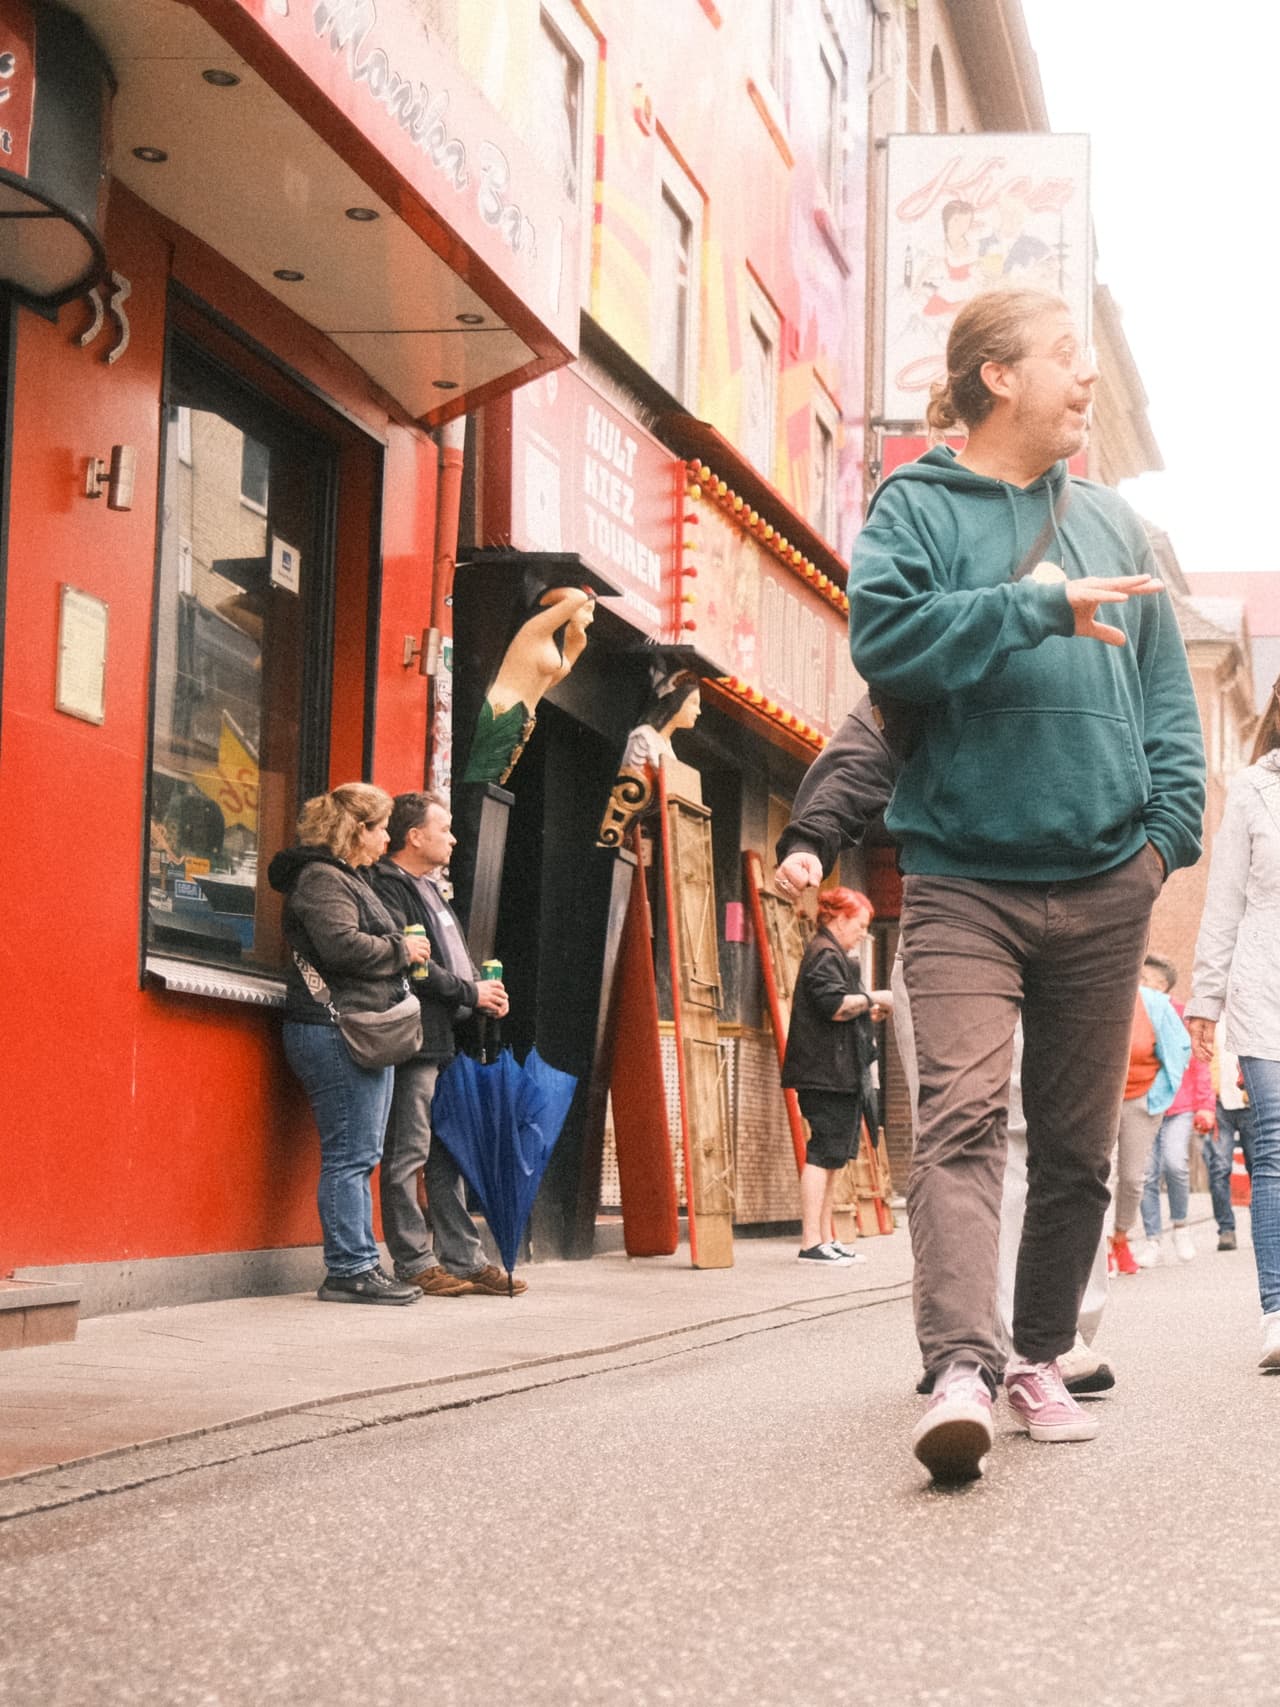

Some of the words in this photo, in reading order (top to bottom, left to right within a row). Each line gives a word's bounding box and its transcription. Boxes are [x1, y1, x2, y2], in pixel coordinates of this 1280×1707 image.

[586, 404, 638, 478] KULT
[583, 452, 636, 527] KIEZ
[584, 500, 661, 593] TOUREN
